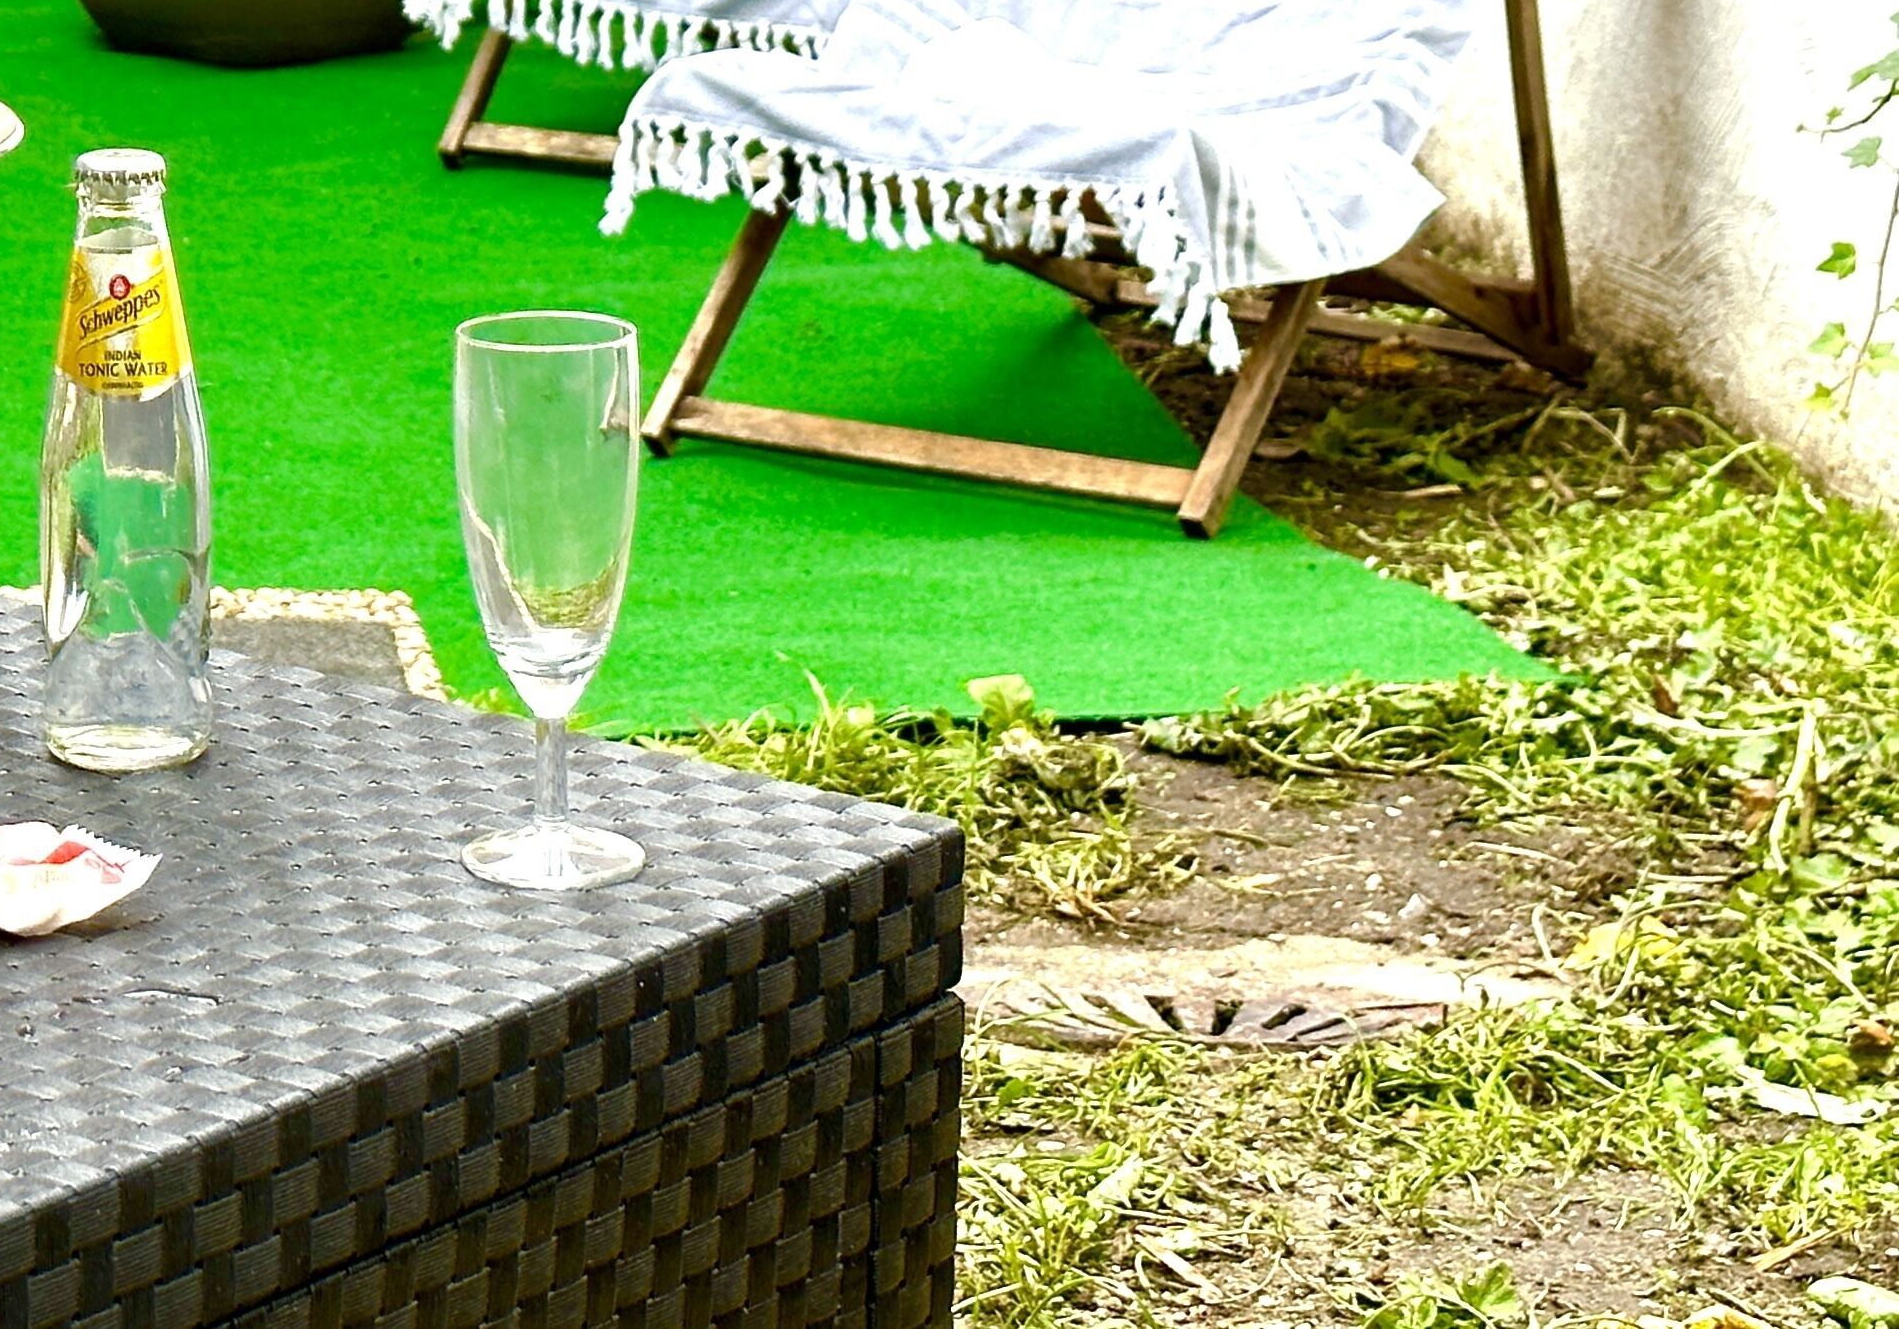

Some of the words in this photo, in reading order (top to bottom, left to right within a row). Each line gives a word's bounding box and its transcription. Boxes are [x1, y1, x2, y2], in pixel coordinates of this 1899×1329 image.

[79, 287, 161, 340] Schweppes
[104, 350, 142, 361] INDIAN
[79, 362, 120, 378] TONIC
[124, 361, 167, 377] WATER
